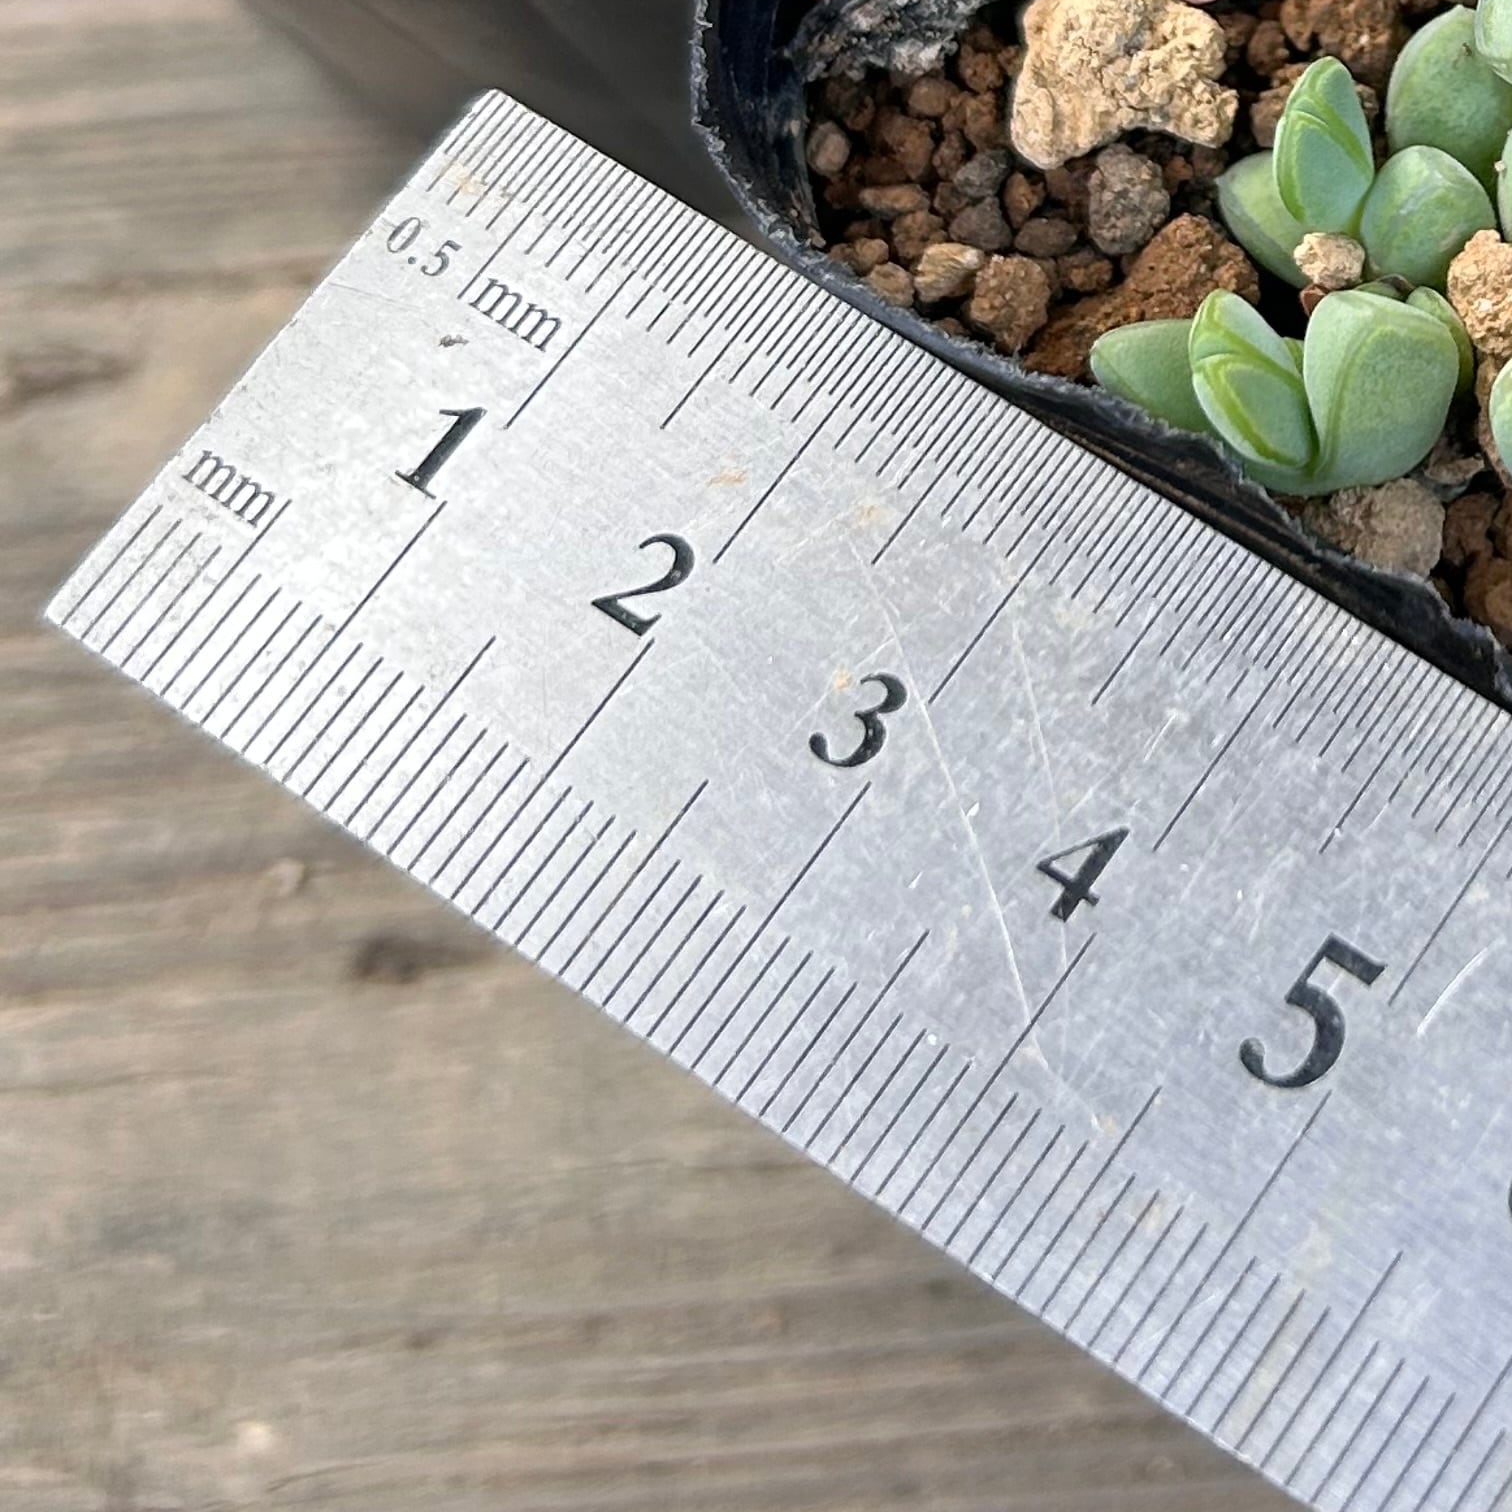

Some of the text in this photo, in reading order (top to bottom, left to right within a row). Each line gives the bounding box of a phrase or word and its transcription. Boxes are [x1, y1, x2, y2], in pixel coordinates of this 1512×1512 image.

[386, 216, 562, 353] 0.5 mm
[181, 449, 277, 529] mm
[394, 406, 488, 500] 1
[590, 532, 695, 636] 2
[808, 672, 908, 768] 3
[1036, 827, 1130, 923] 4
[1239, 933, 1386, 1089] 5
